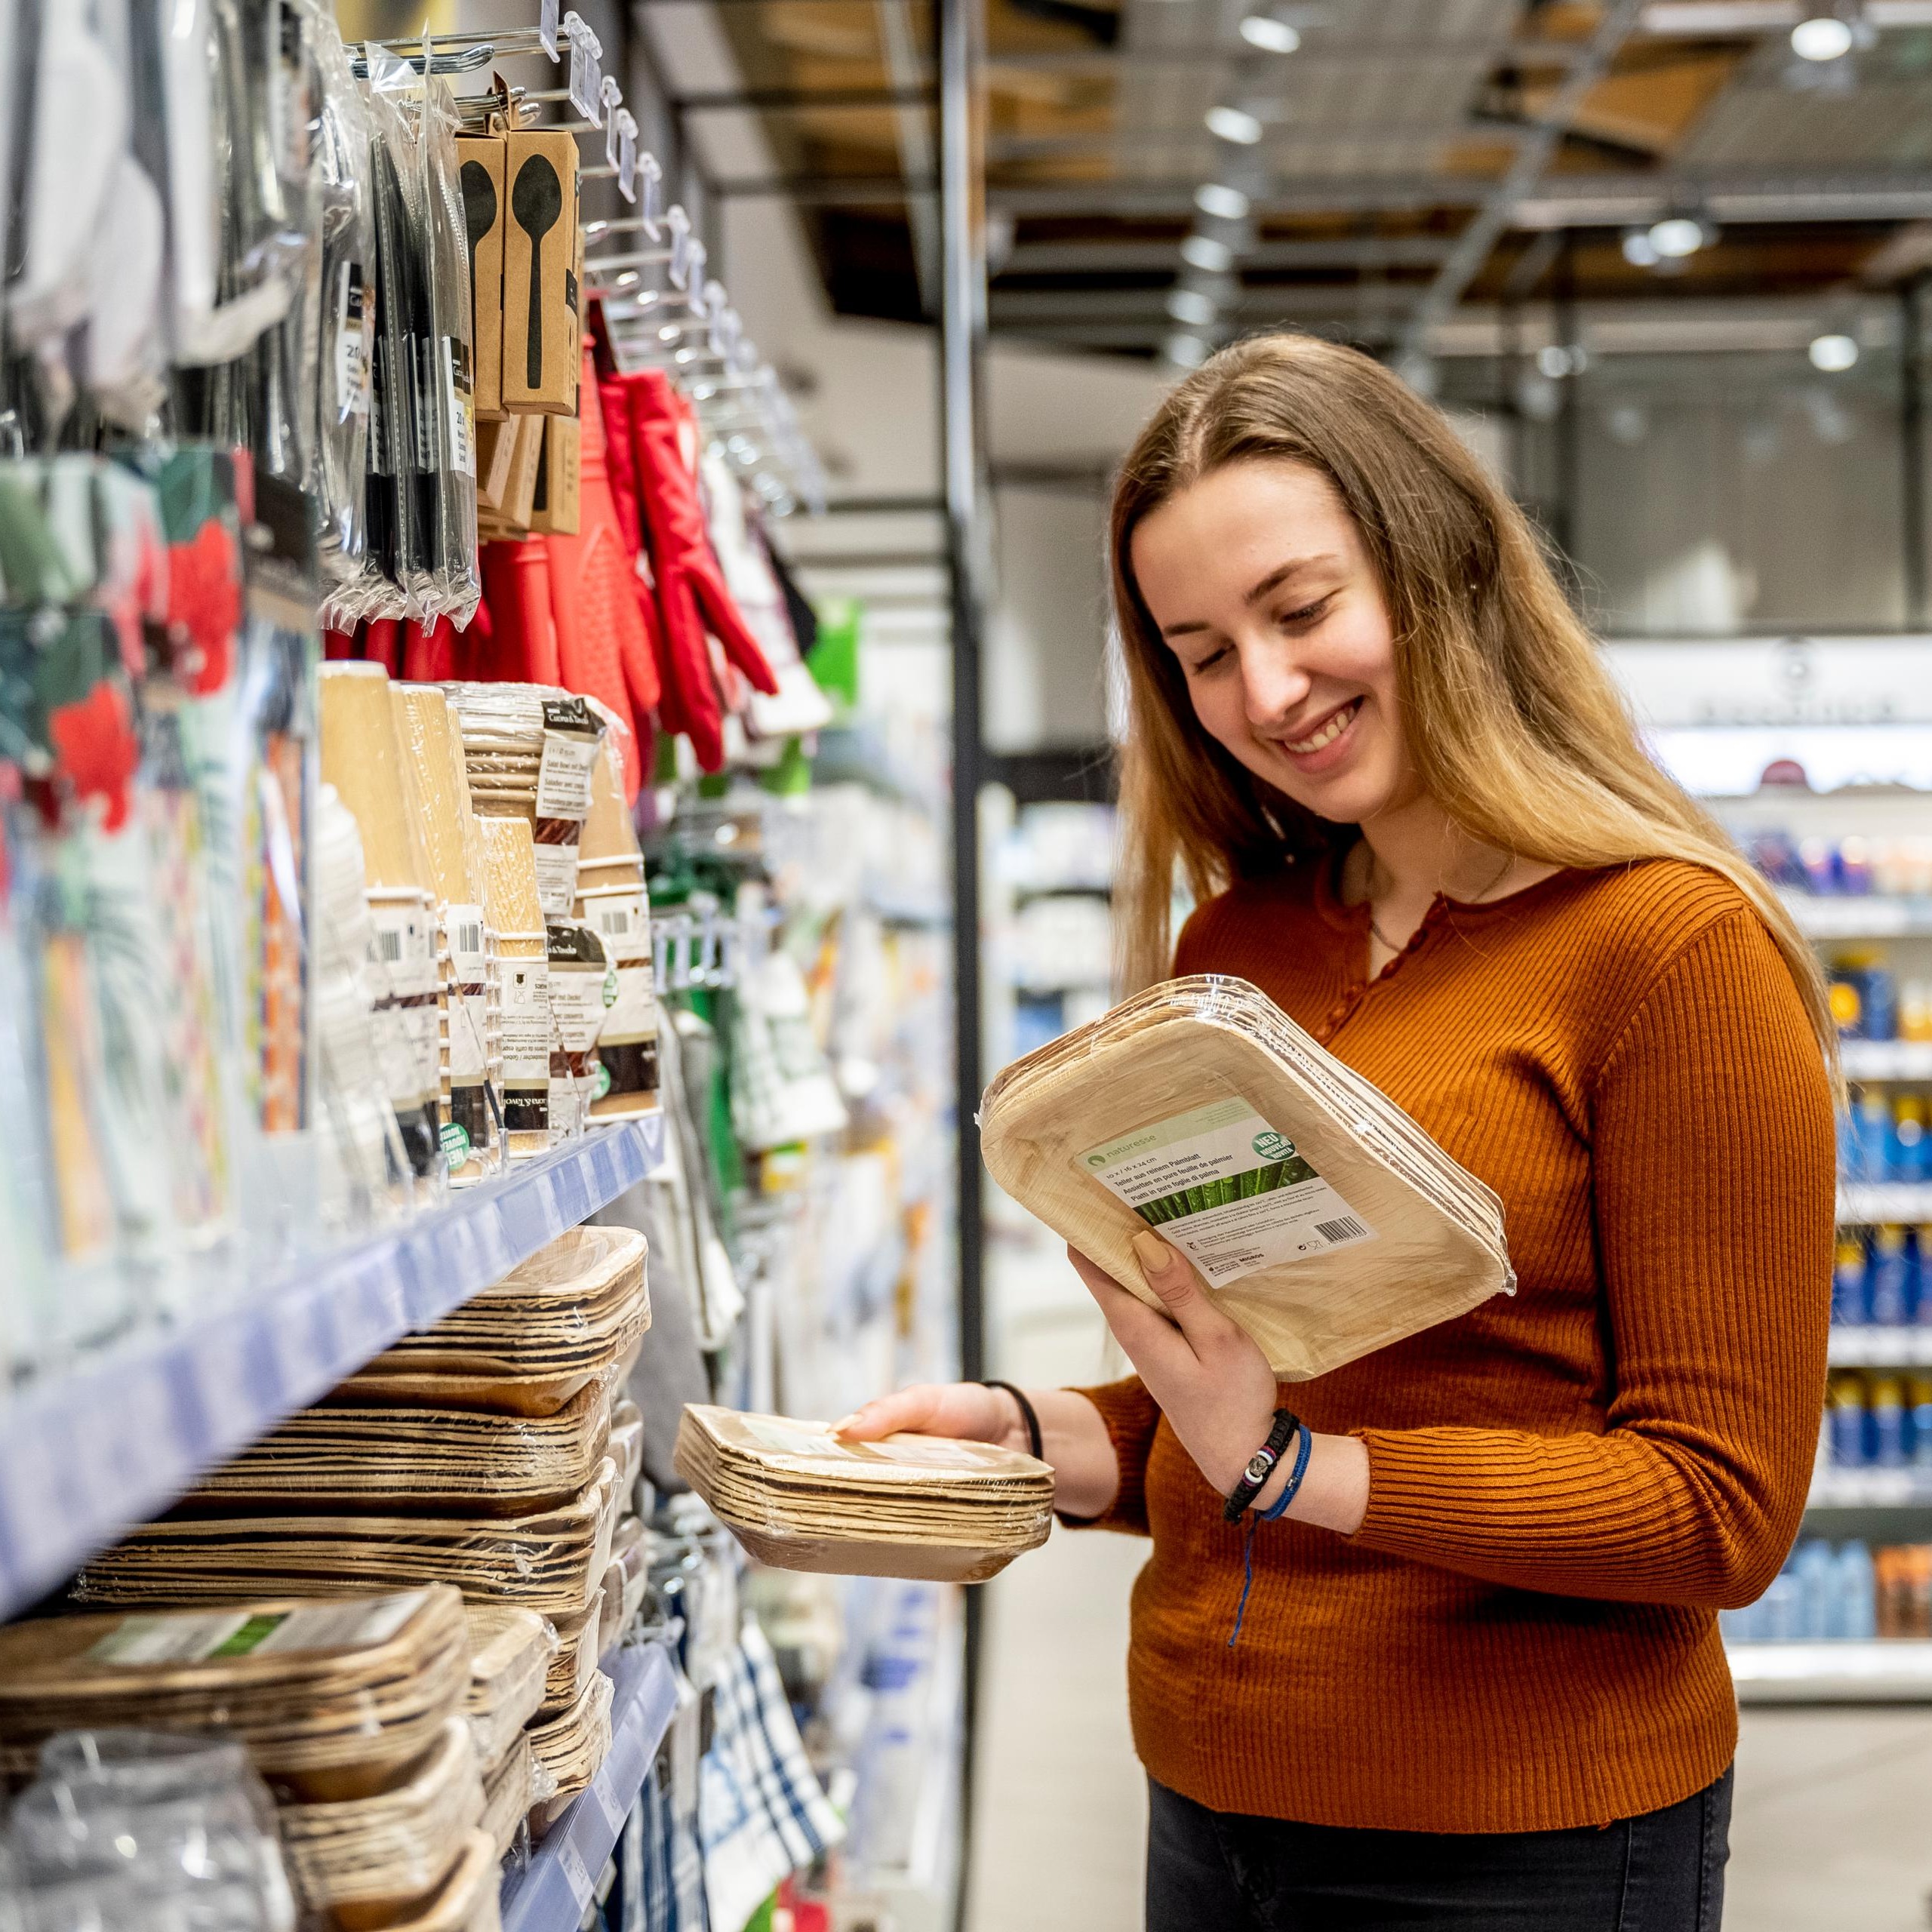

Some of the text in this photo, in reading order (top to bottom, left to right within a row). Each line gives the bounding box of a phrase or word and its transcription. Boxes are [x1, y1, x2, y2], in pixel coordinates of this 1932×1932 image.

[1106, 1134, 1157, 1158] naturesse
[1254, 1134, 1280, 1148] NEU
[1260, 1138, 1292, 1157] NOUVEAU
[1114, 1177, 1133, 1187] Teller
[1147, 1164, 1169, 1177] reinem
[1169, 1153, 1201, 1168] Palmblatt
[1123, 1181, 1153, 1195] Assiettes
[1163, 1171, 1178, 1183] pure
[1178, 1164, 1199, 1177] feuille
[1199, 1160, 1208, 1168] de
[1208, 1154, 1233, 1168] palmier
[1131, 1191, 1148, 1201] Piatti
[1157, 1183, 1173, 1195] pure
[1172, 1177, 1191, 1190] foglie
[1191, 1174, 1198, 1182] di
[1198, 1169, 1220, 1181] palma
[1239, 1254, 1264, 1262] MIGROS
